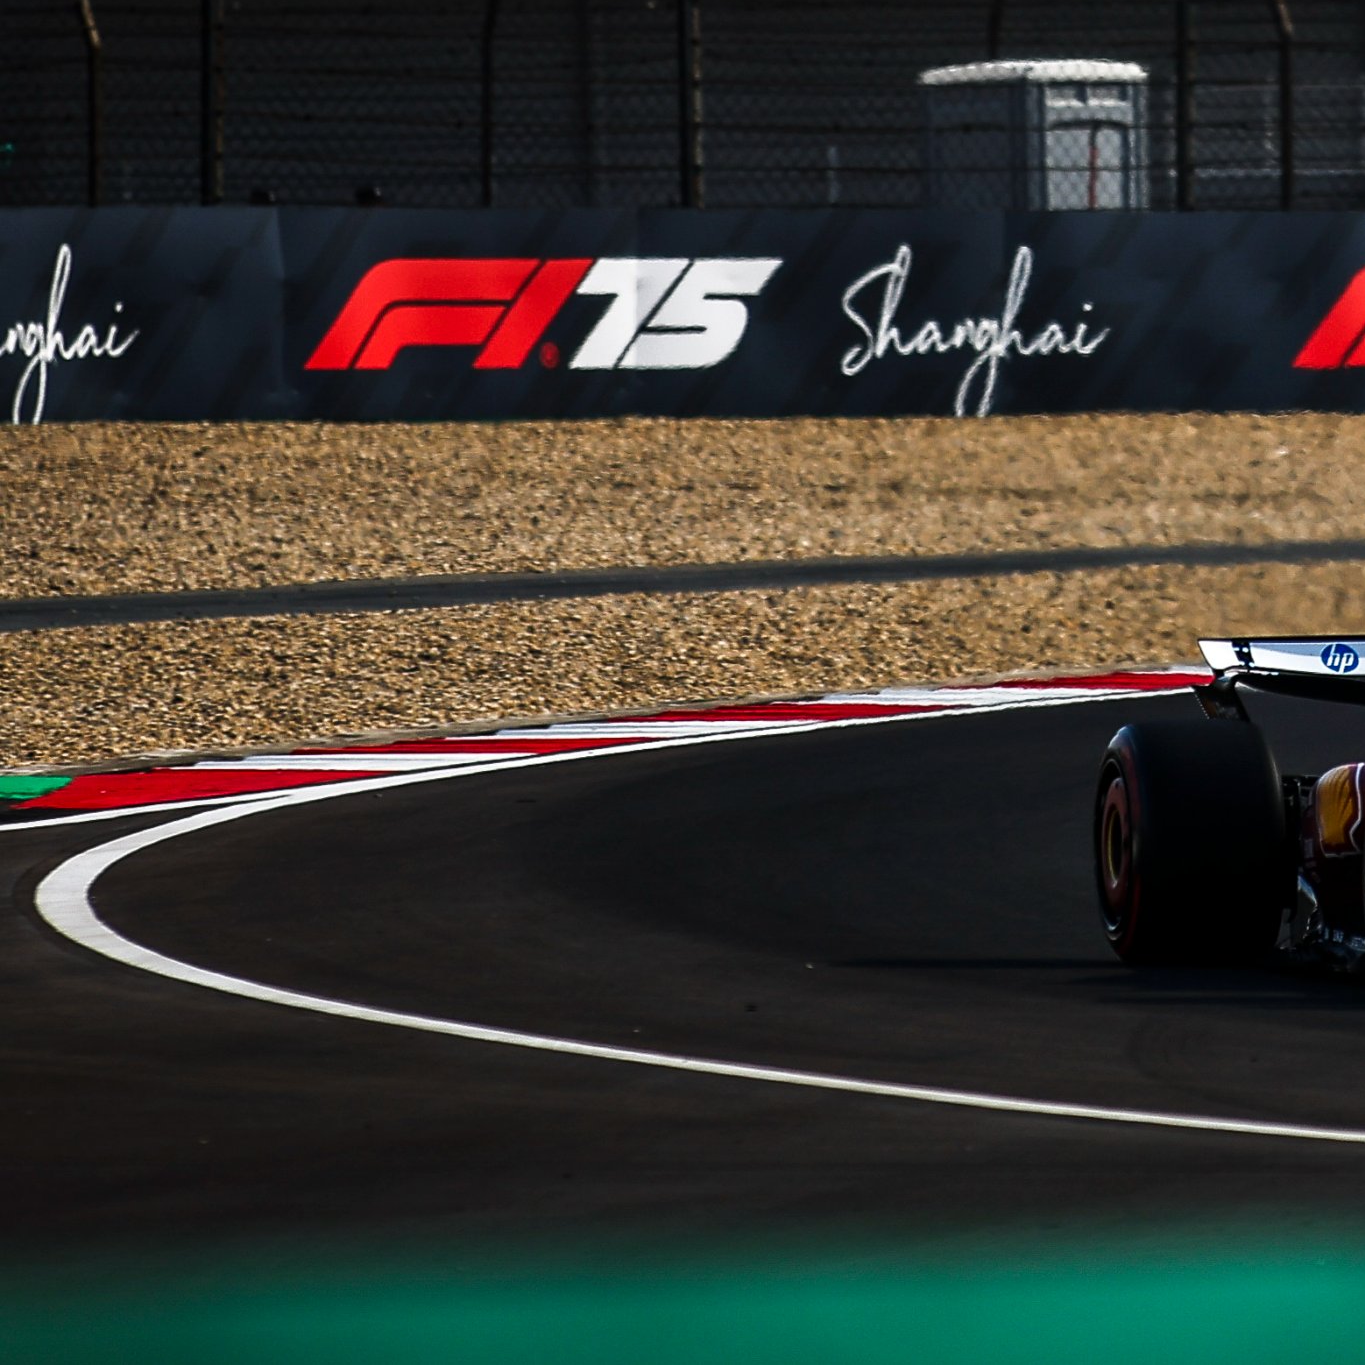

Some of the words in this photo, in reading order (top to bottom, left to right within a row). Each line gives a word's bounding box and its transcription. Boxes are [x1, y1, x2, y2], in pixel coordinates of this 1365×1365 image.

[0, 243, 140, 424] nghai
[841, 244, 1111, 416] Shanghai
[1327, 645, 1355, 672] hp
